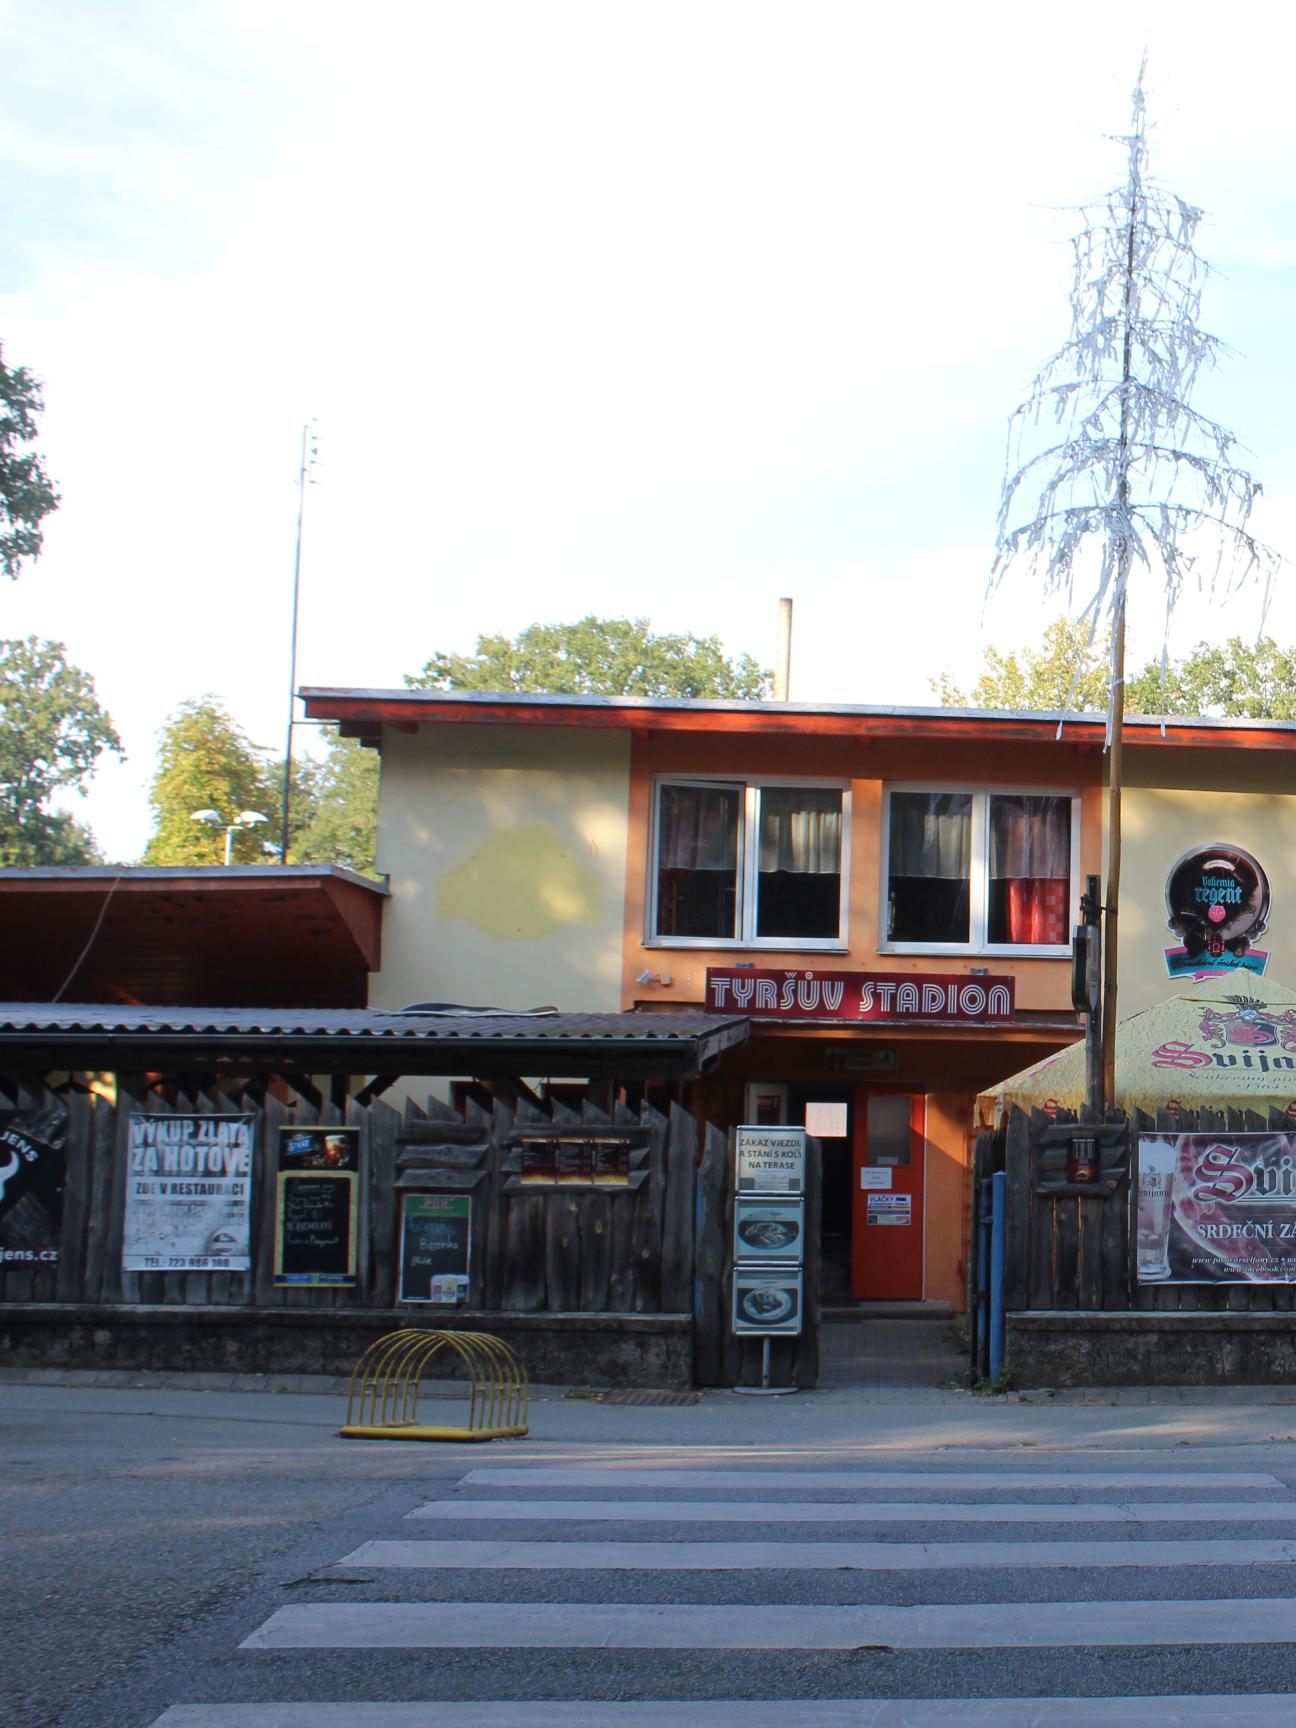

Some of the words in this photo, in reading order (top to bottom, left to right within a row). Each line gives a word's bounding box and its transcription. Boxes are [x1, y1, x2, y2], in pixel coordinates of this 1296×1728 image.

[1202, 876, 1235, 887] Bohemia
[1195, 886, 1242, 905] regent
[711, 972, 844, 1010] TYRŠŮV
[859, 982, 1010, 1015] STADION
[740, 1138, 769, 1146] ZÁKAZ
[132, 1146, 159, 1171] ZA
[747, 1150, 773, 1158] STÁNÍ
[160, 1183, 167, 1194] V
[1197, 1219, 1274, 1239] SRDEČNÍ
